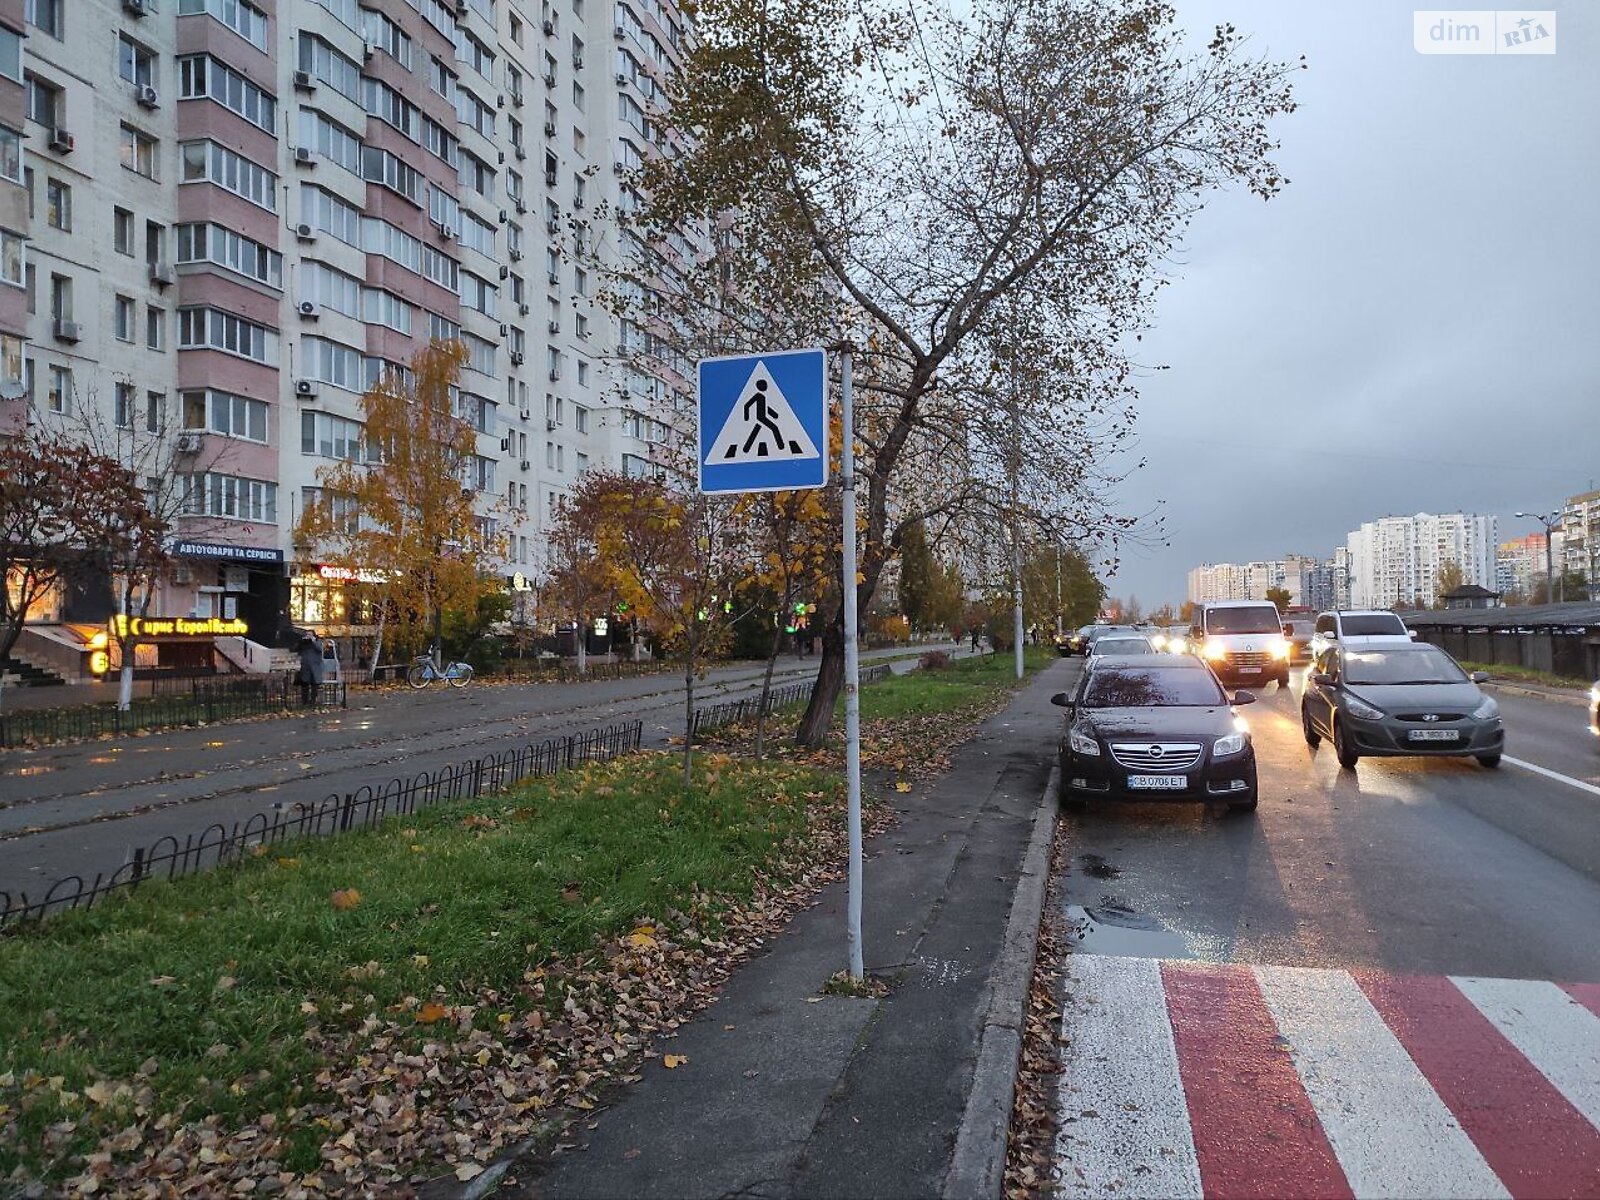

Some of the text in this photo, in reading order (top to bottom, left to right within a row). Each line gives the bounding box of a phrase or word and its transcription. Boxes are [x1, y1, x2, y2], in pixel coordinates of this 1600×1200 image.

[180, 544, 277, 560] АВТОТОВАРИ ТА СЕРВІСИ
